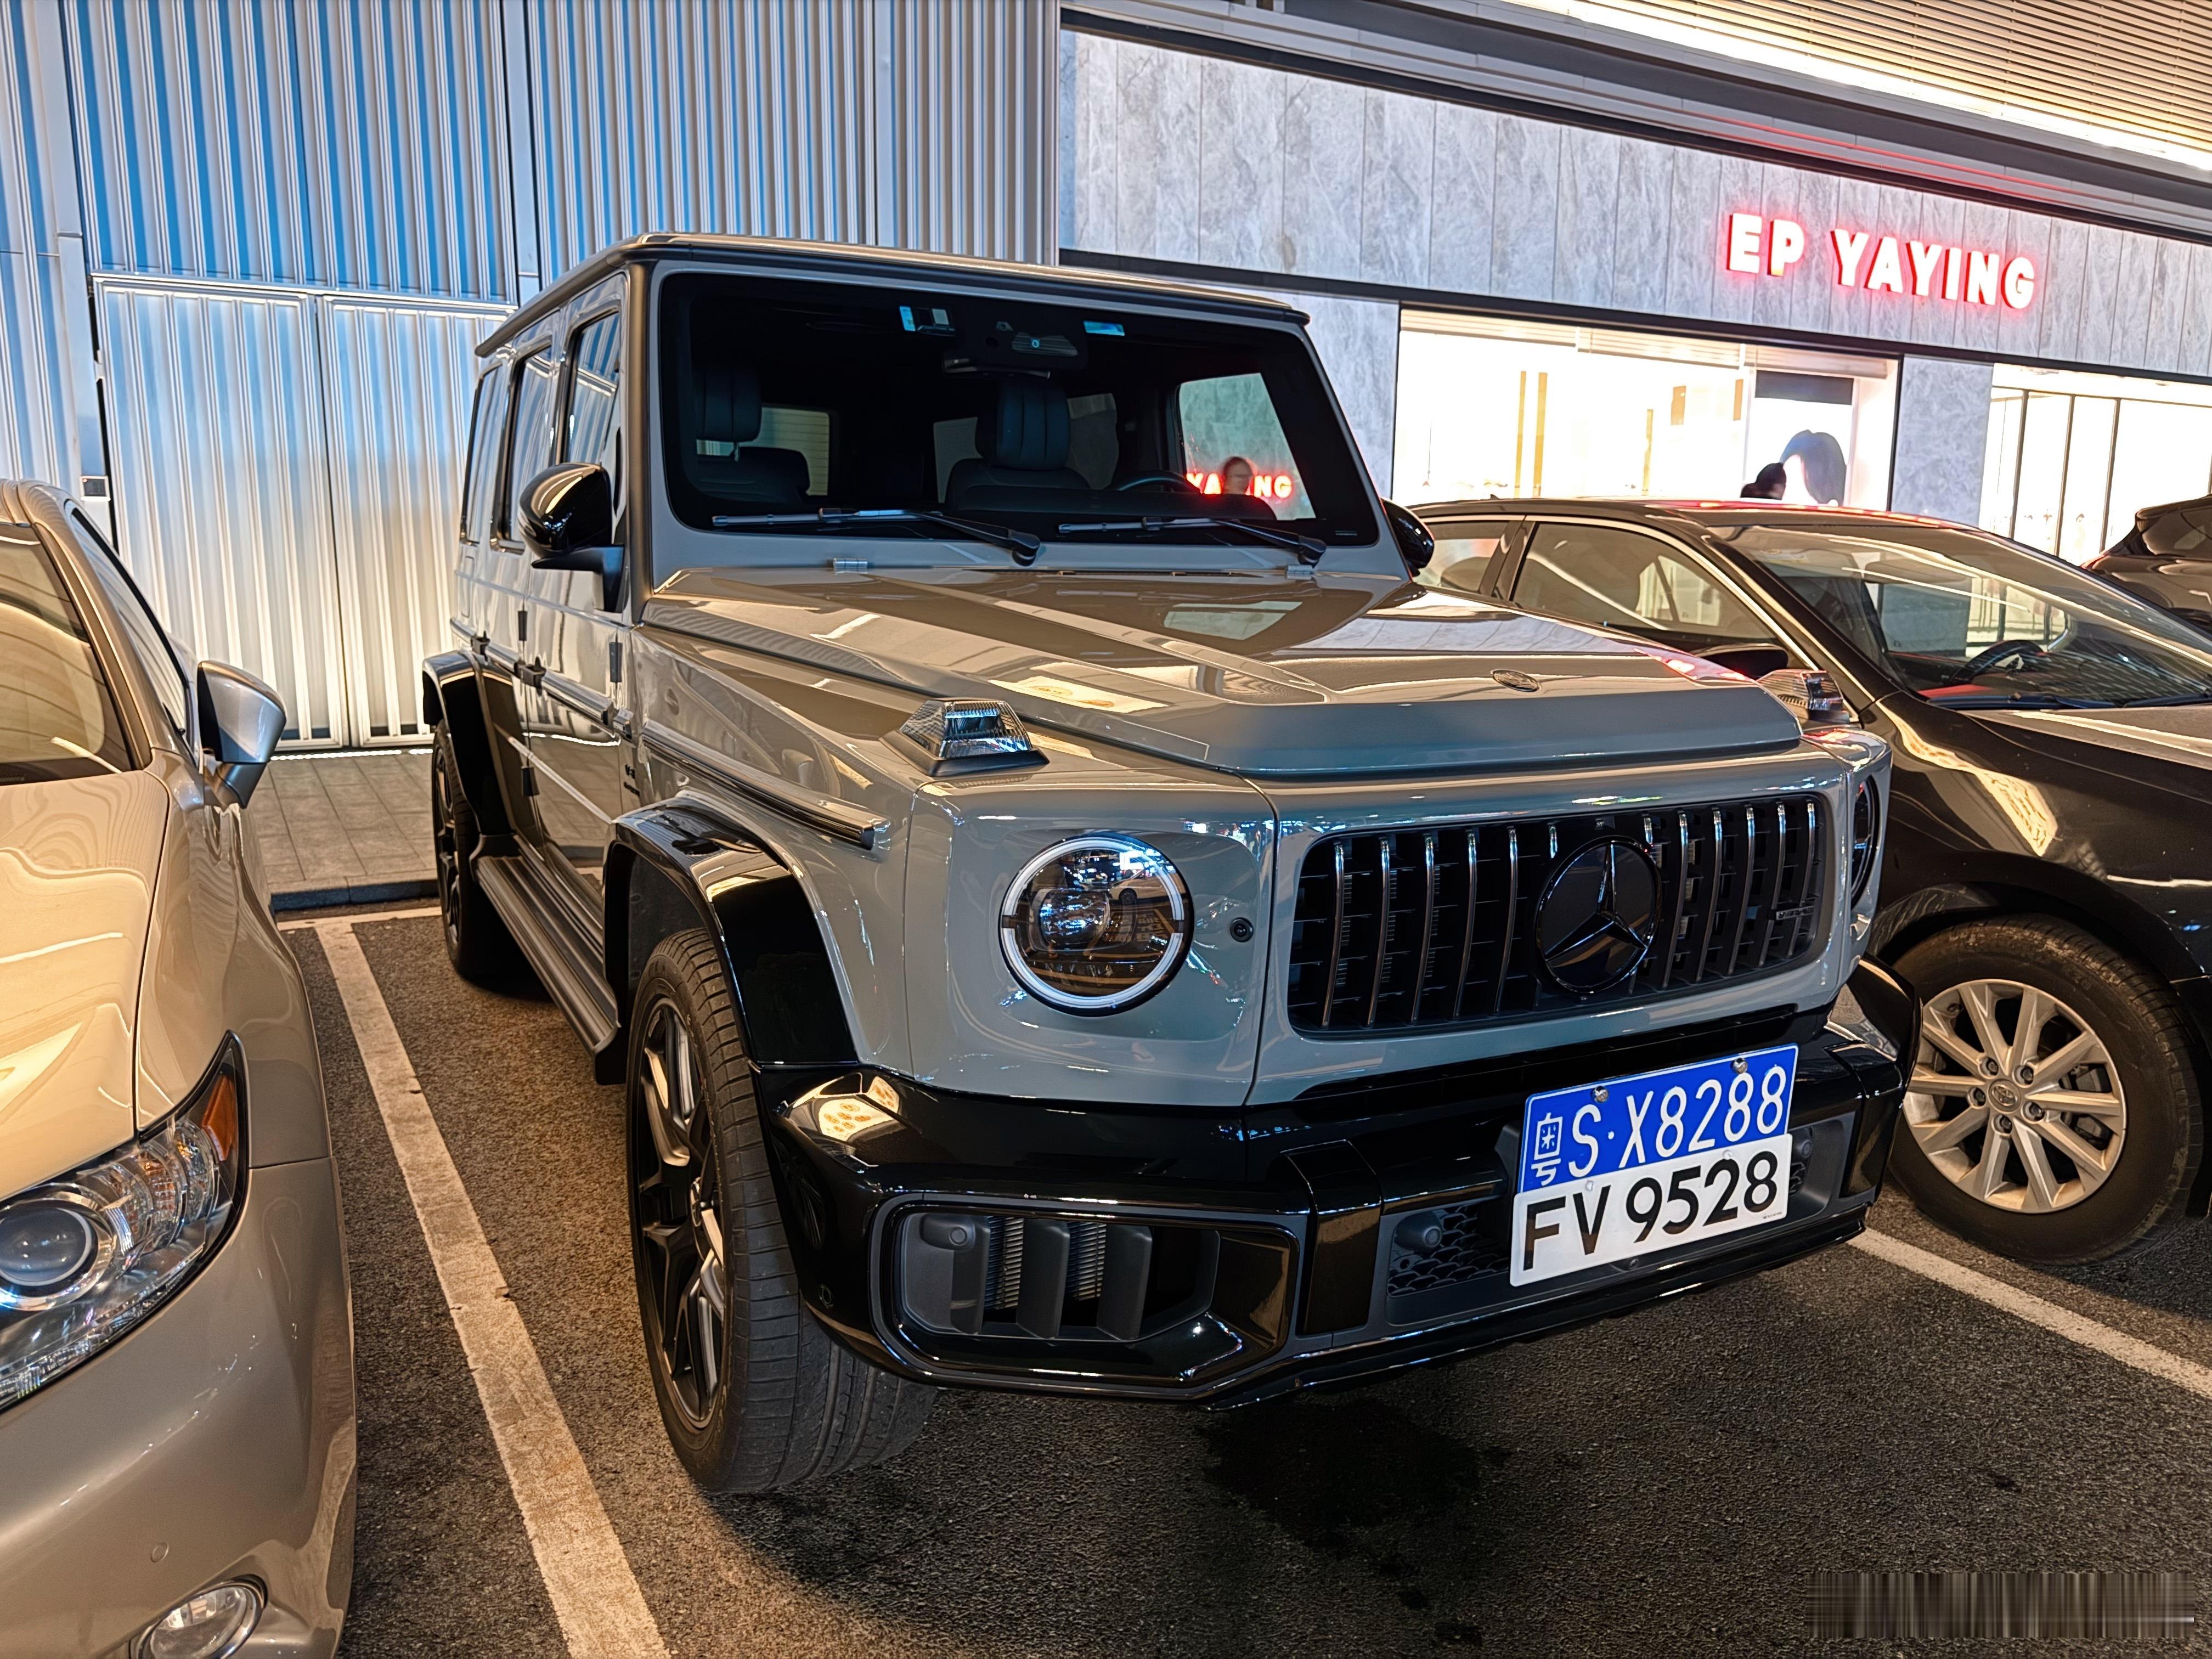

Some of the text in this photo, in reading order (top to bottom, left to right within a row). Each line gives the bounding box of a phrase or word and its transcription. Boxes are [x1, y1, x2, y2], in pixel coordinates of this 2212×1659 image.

[1726, 213, 2035, 309] EP YAYING
[1186, 473, 1293, 498] YANG
[1523, 1151, 1778, 1272] FV 9528
